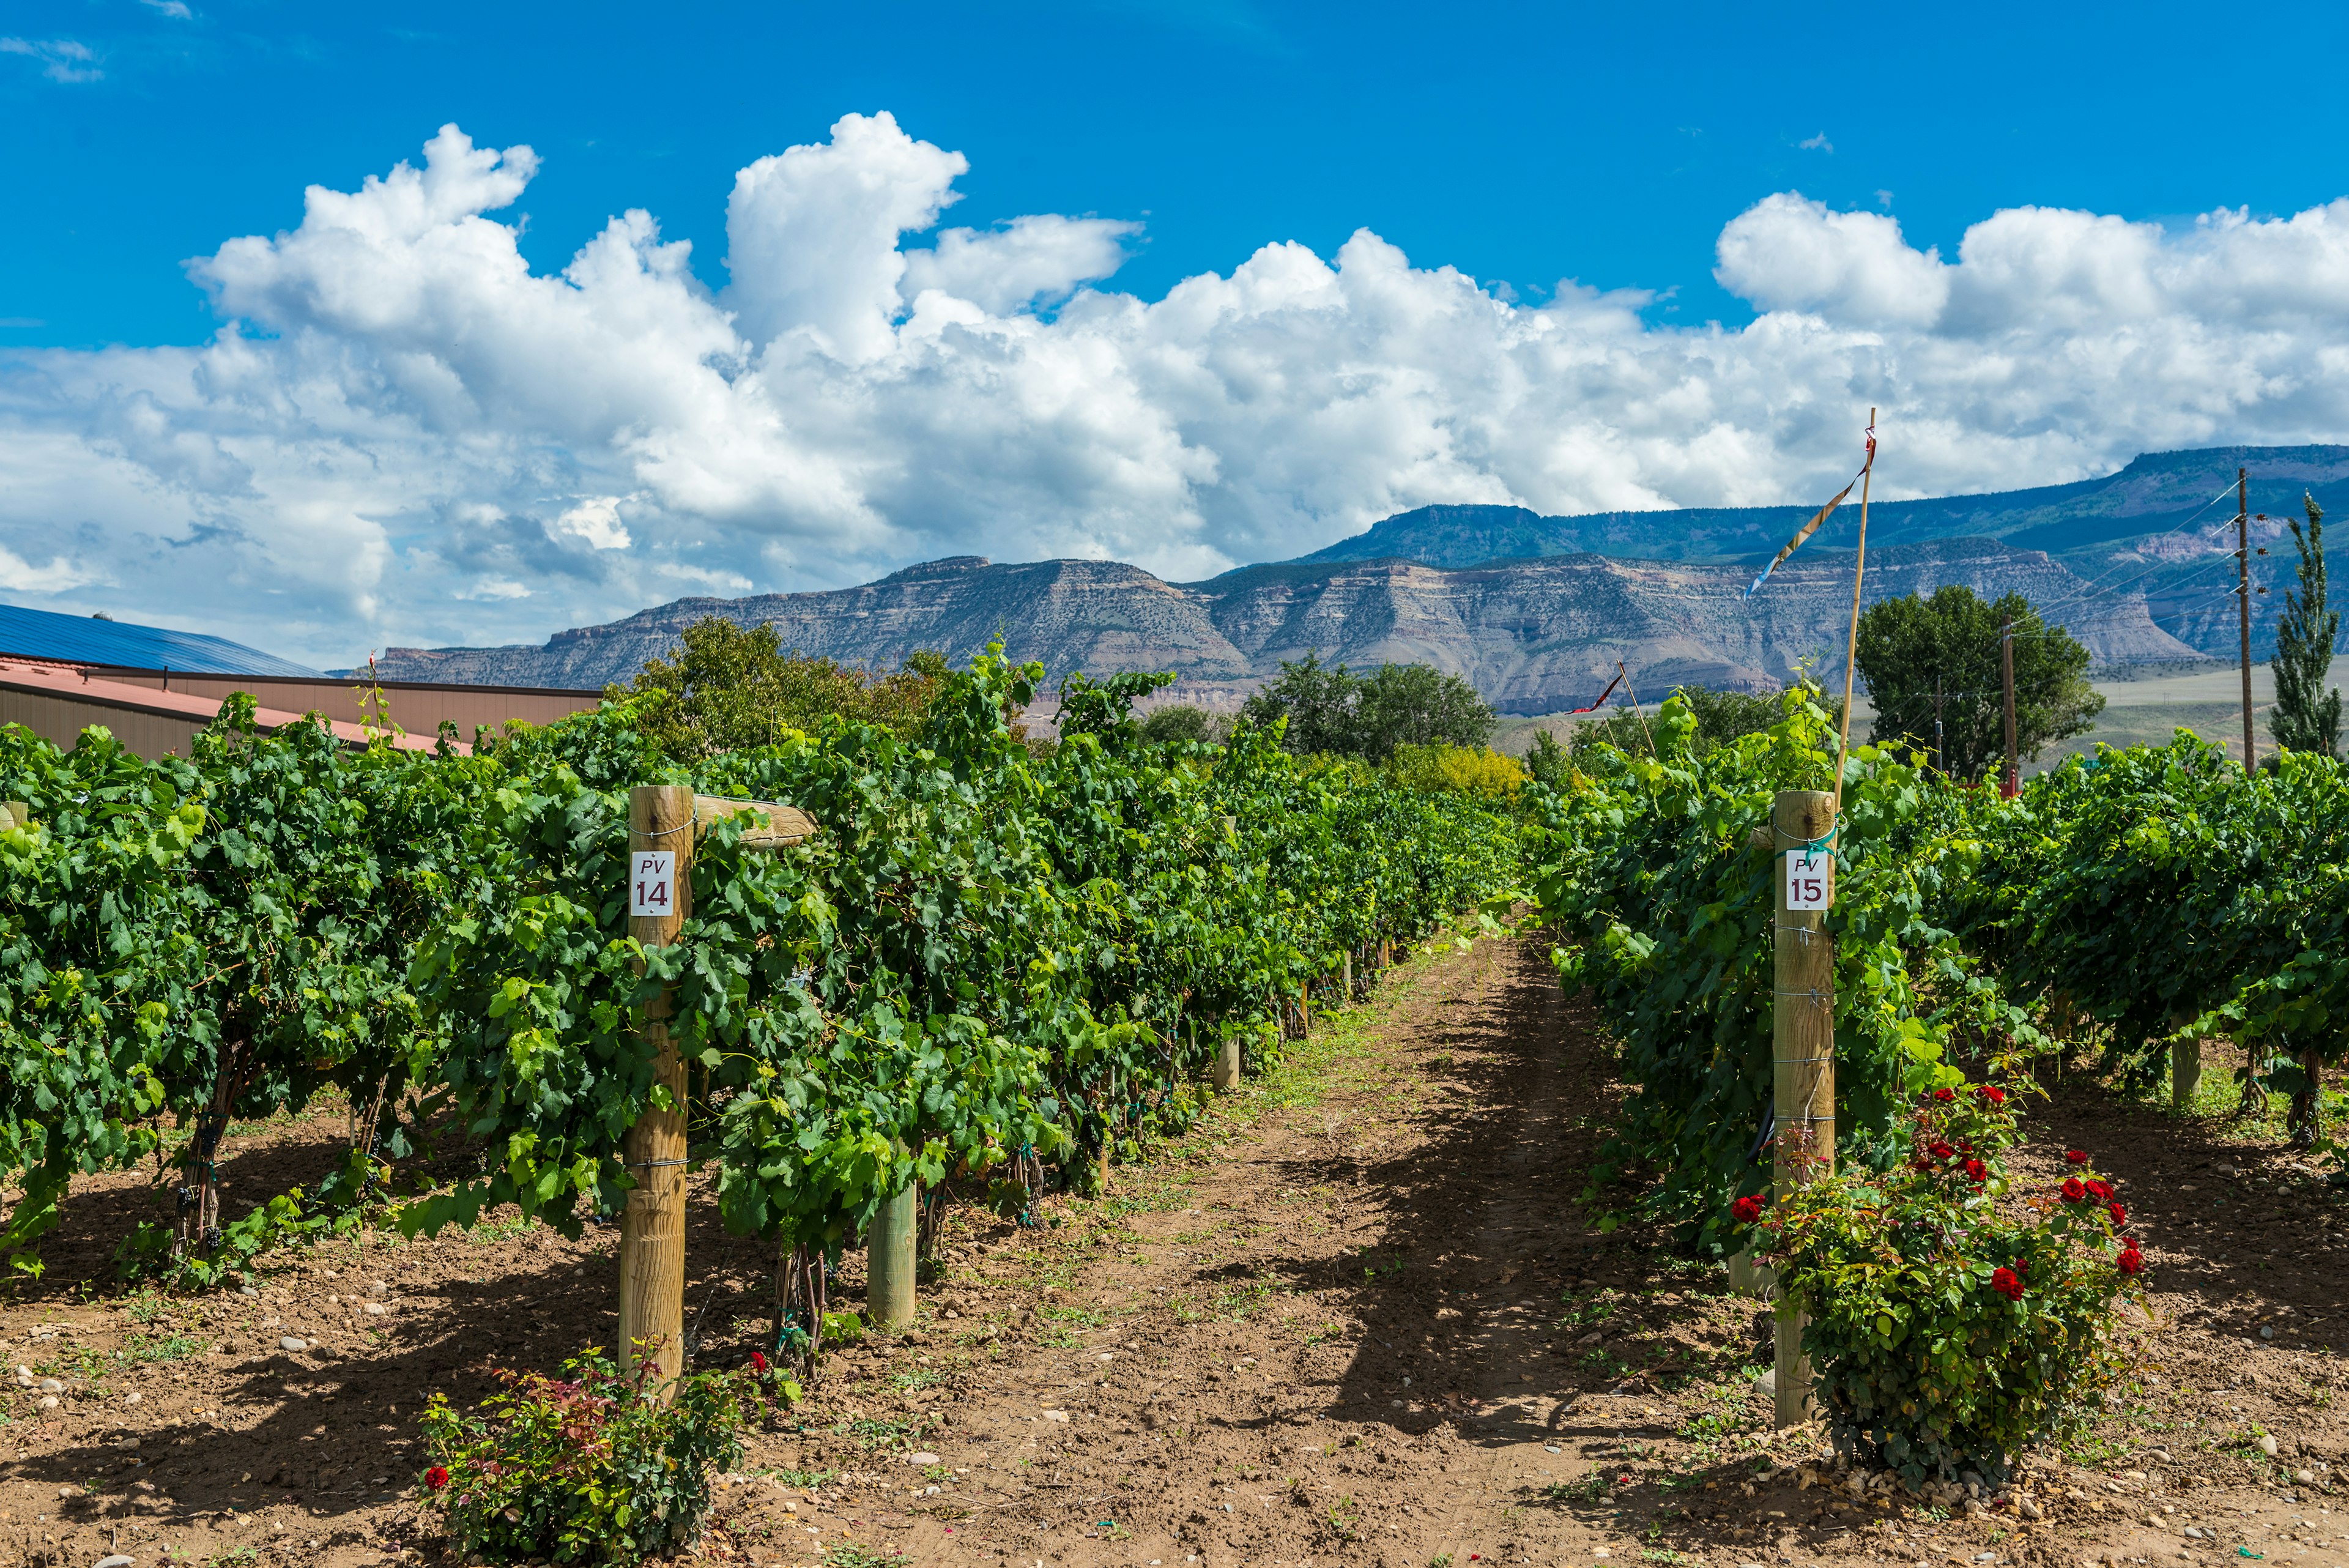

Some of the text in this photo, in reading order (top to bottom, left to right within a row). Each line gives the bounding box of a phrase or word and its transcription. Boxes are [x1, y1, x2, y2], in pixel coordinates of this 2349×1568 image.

[640, 860, 666, 874] PV
[1794, 859, 1819, 872] PV
[637, 881, 667, 905] 14
[1792, 879, 1822, 902] 15
